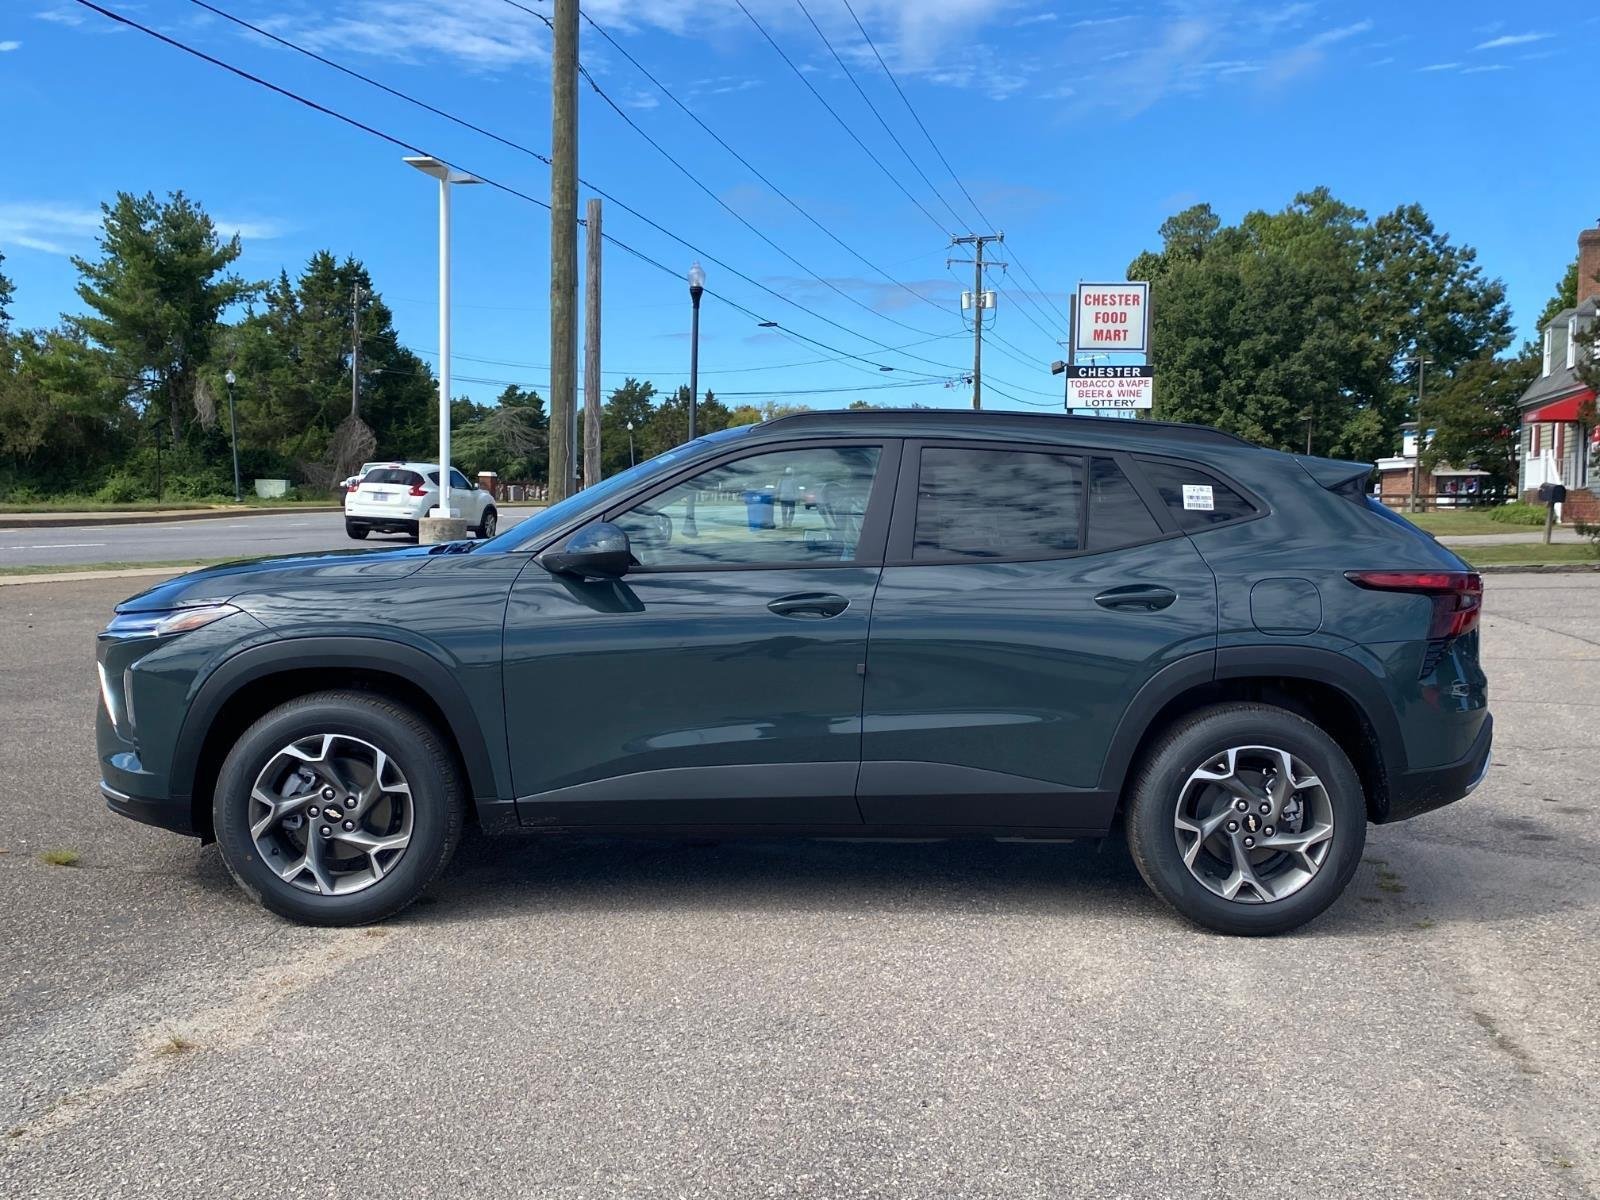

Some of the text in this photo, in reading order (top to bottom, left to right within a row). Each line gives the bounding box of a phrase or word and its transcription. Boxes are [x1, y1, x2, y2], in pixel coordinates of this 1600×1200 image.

[1084, 294, 1140, 306] CHESTER
[1095, 312, 1127, 324] FOOD
[1093, 329, 1129, 341] MART
[1078, 367, 1141, 377] CHESTER
[1070, 380, 1115, 388] TOBACCO
[1078, 390, 1105, 398] BEER
[1117, 390, 1142, 398] WINE
[1085, 399, 1136, 407] LOTTERY
